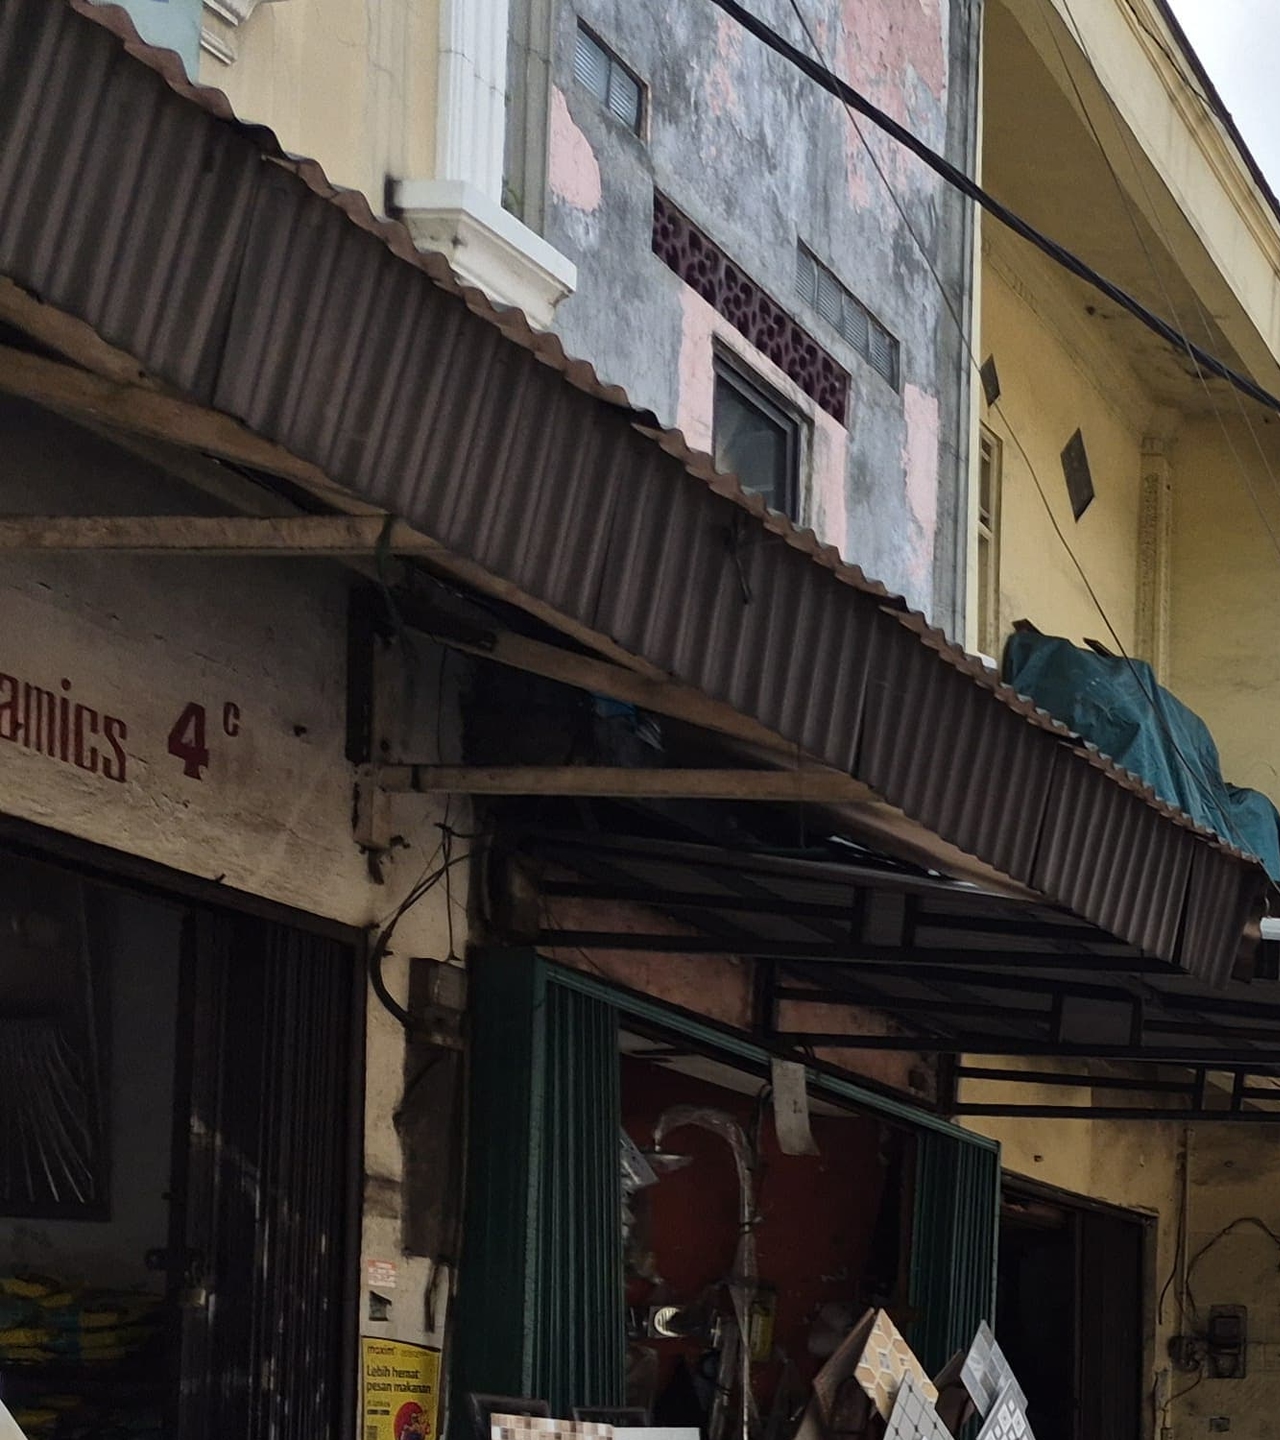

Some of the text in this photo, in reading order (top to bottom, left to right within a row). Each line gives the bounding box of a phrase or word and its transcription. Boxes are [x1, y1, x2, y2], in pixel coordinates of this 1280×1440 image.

[367, 1365, 391, 1378] Lebih
[367, 1382, 392, 1394] pesan
[394, 1381, 432, 1395] makanan
